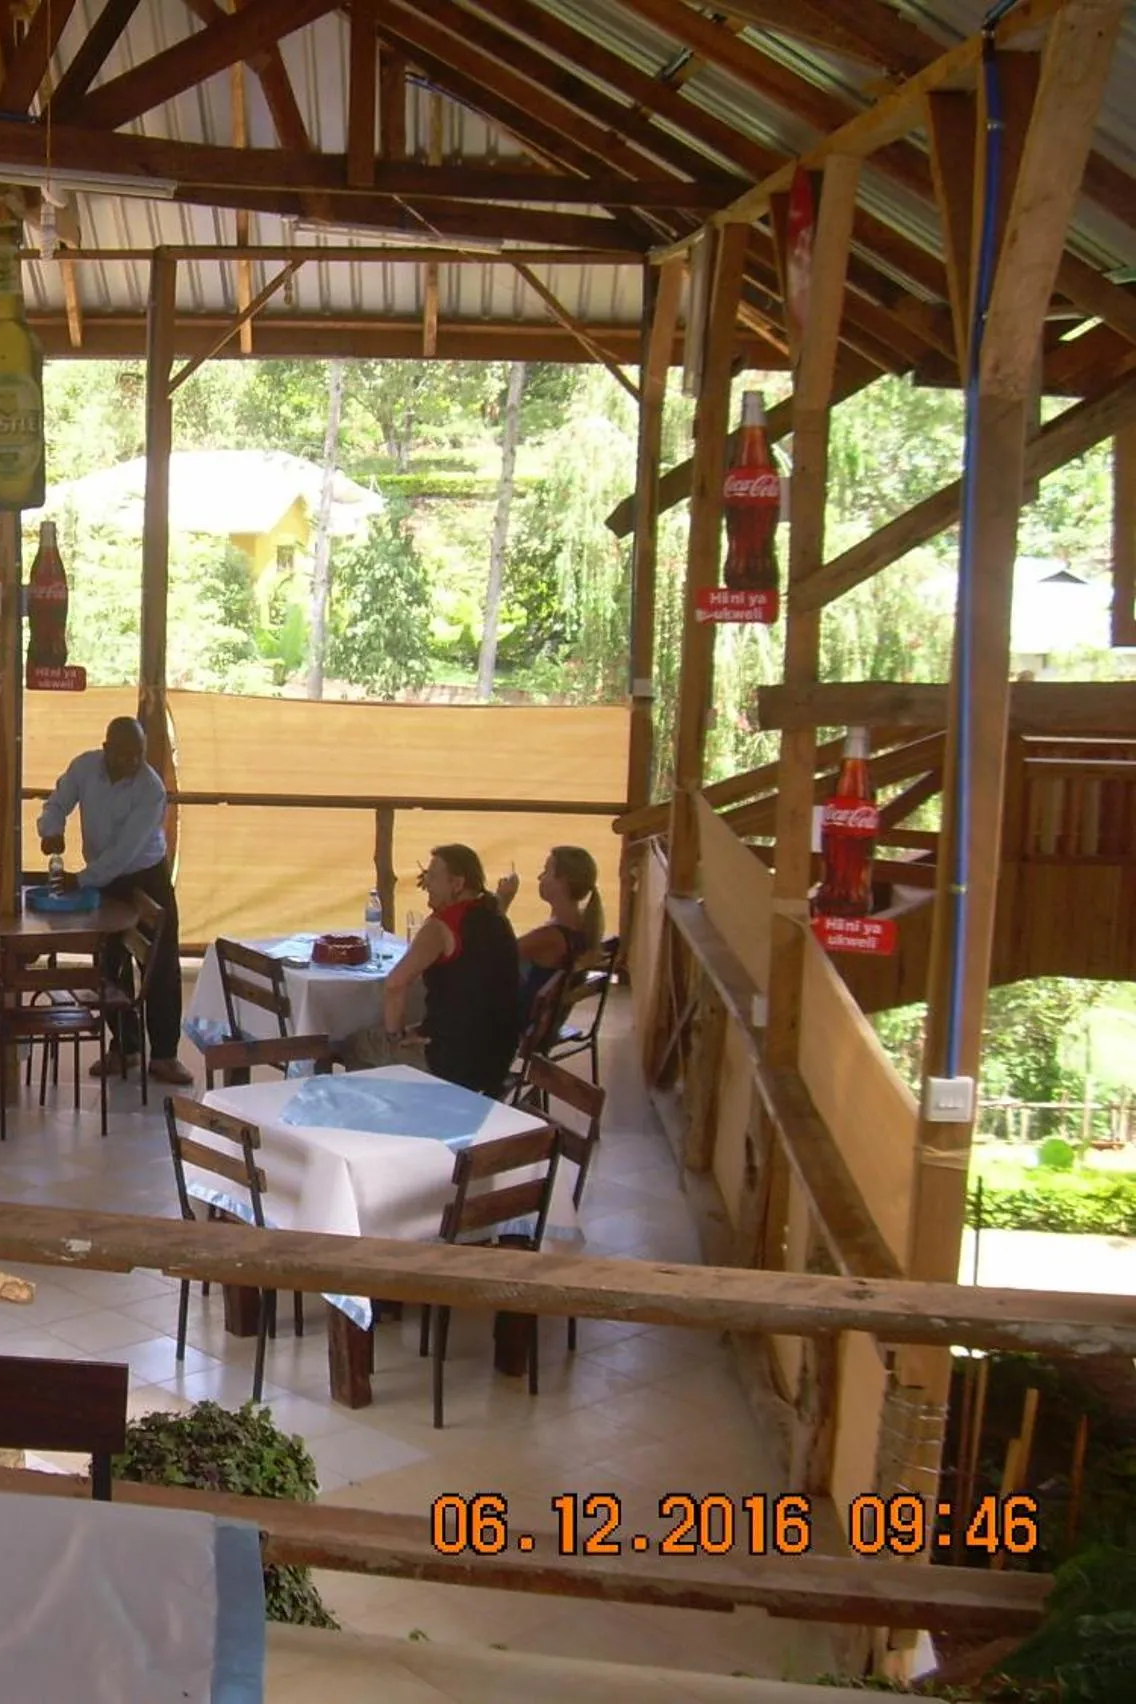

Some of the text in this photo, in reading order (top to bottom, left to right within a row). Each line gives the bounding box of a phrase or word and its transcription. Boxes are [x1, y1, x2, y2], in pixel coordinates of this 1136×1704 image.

[747, 593, 768, 608] ya
[863, 923, 882, 936] ya
[828, 934, 876, 949] ukweli
